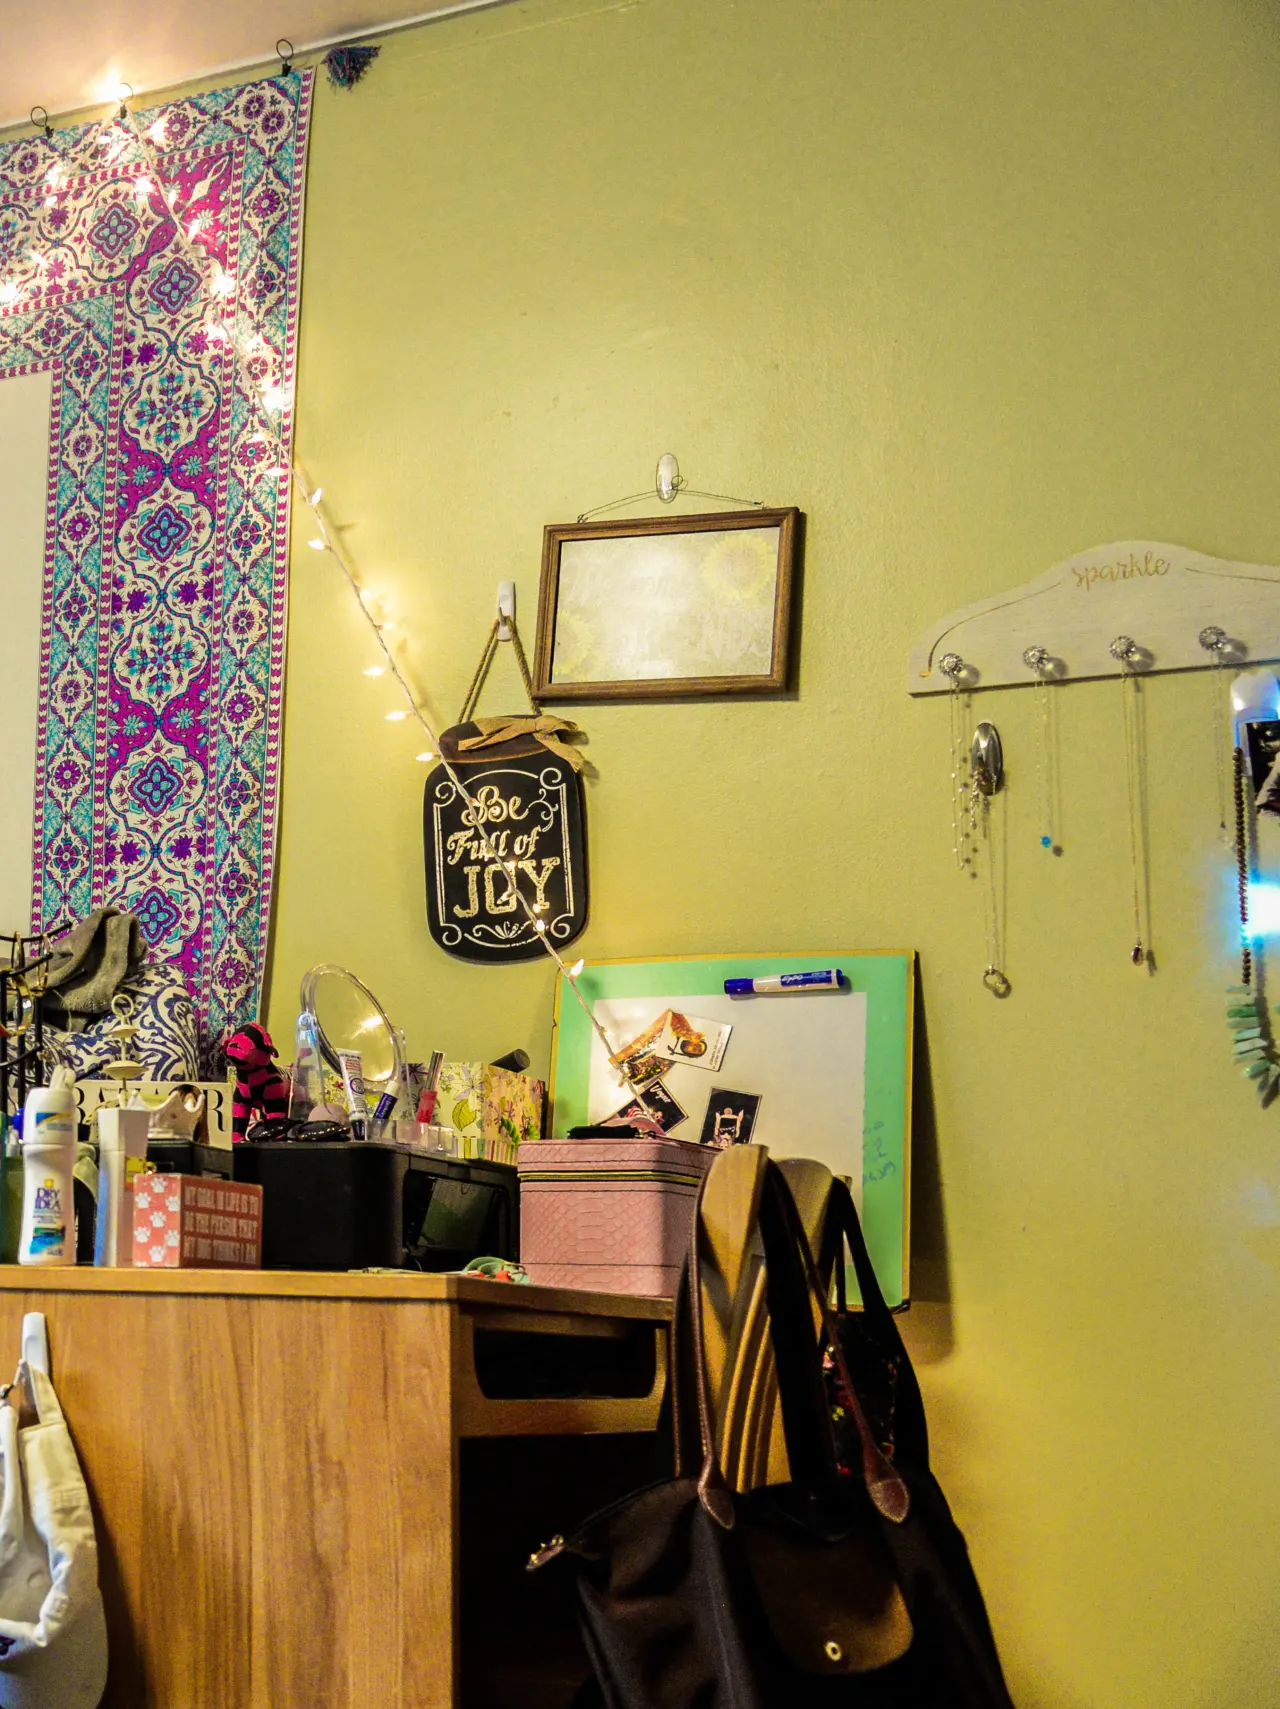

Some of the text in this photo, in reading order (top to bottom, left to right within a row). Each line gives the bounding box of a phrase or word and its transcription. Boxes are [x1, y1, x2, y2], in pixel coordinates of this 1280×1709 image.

[1070, 550, 1171, 592] sparkle
[461, 785, 529, 827] Be
[447, 825, 542, 866] Full of
[453, 856, 561, 918] JOY
[35, 1198, 61, 1211] IDEA
[36, 1187, 61, 1200] DRY
[225, 1191, 240, 1213] LIFE
